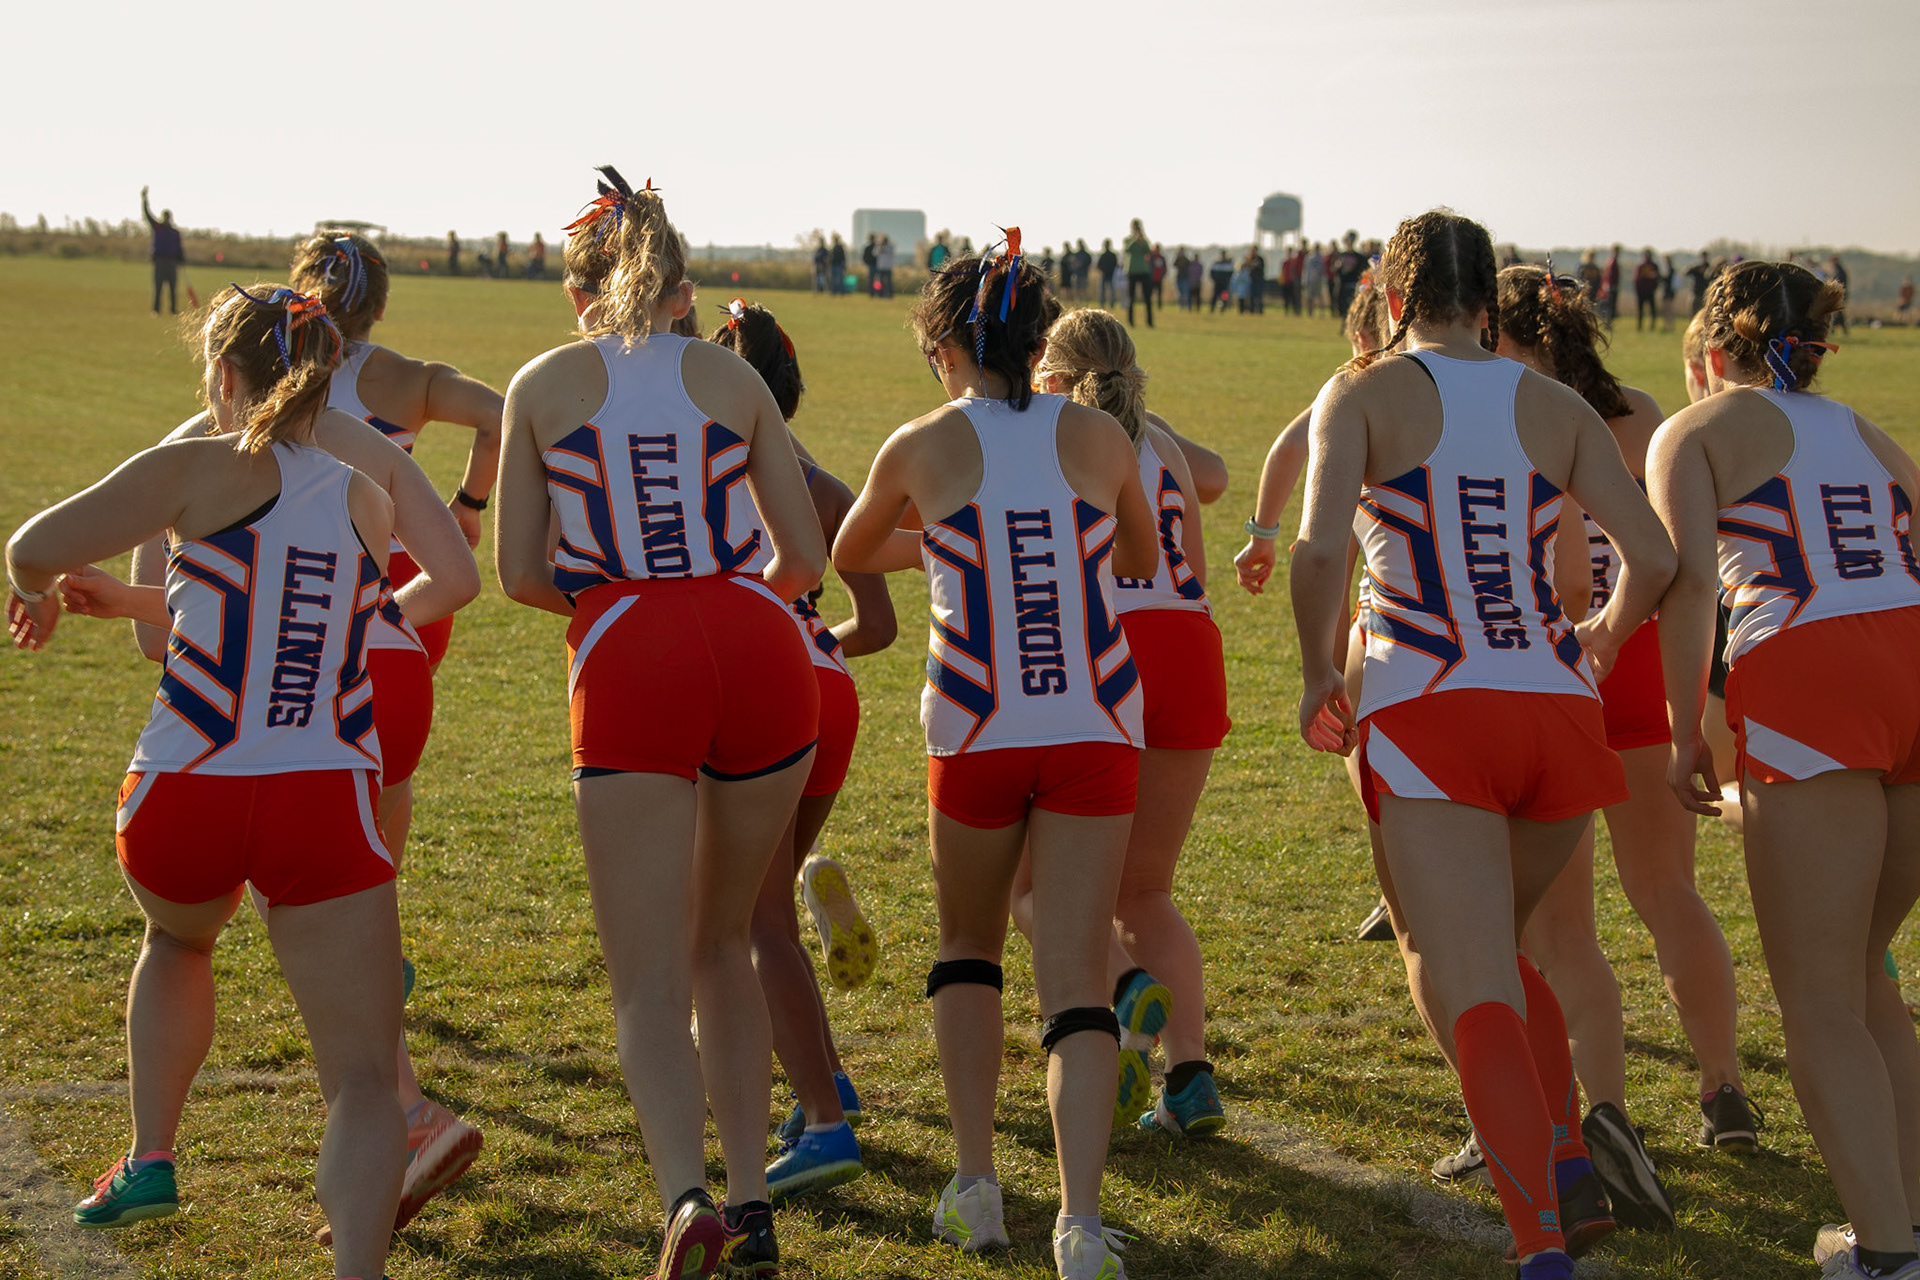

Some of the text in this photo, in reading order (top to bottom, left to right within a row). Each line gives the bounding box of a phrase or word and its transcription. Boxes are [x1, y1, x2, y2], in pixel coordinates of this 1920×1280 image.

[627, 433, 693, 580] ILLINO
[1457, 475, 1532, 650] ILLINOIS
[266, 545, 338, 728] ILLINOIS
[1005, 508, 1068, 696] ILLINOIS
